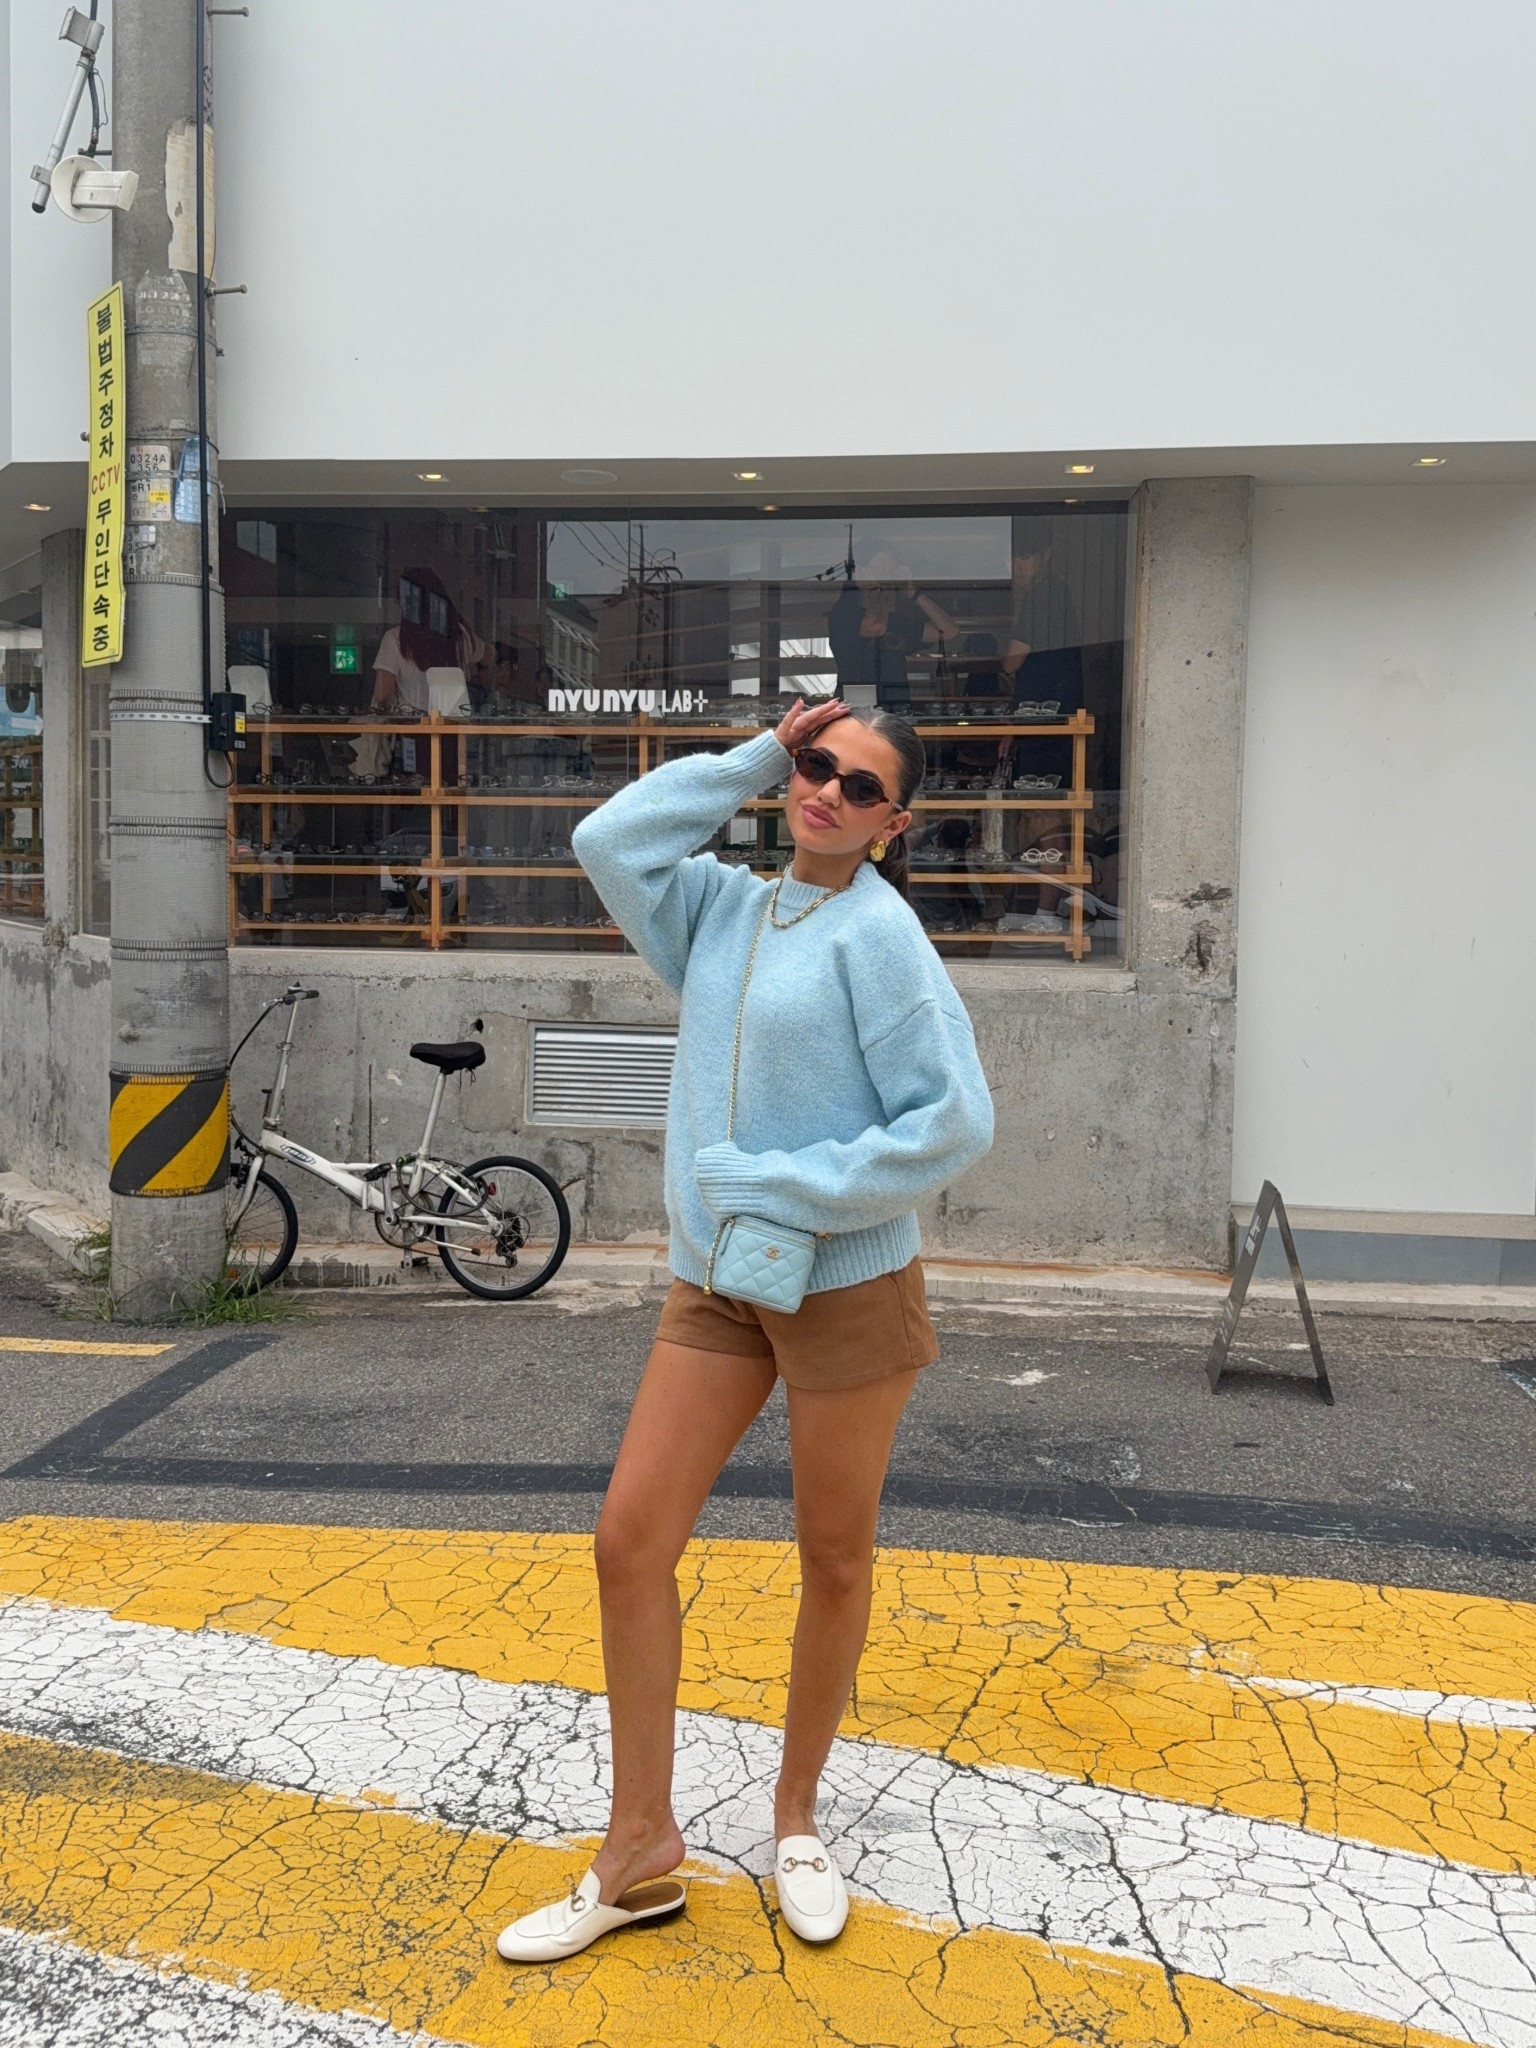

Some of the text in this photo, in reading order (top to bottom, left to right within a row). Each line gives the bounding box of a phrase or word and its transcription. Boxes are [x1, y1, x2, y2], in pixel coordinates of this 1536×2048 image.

[91, 303, 121, 652] 불법주정차 CCTV 무인단속중
